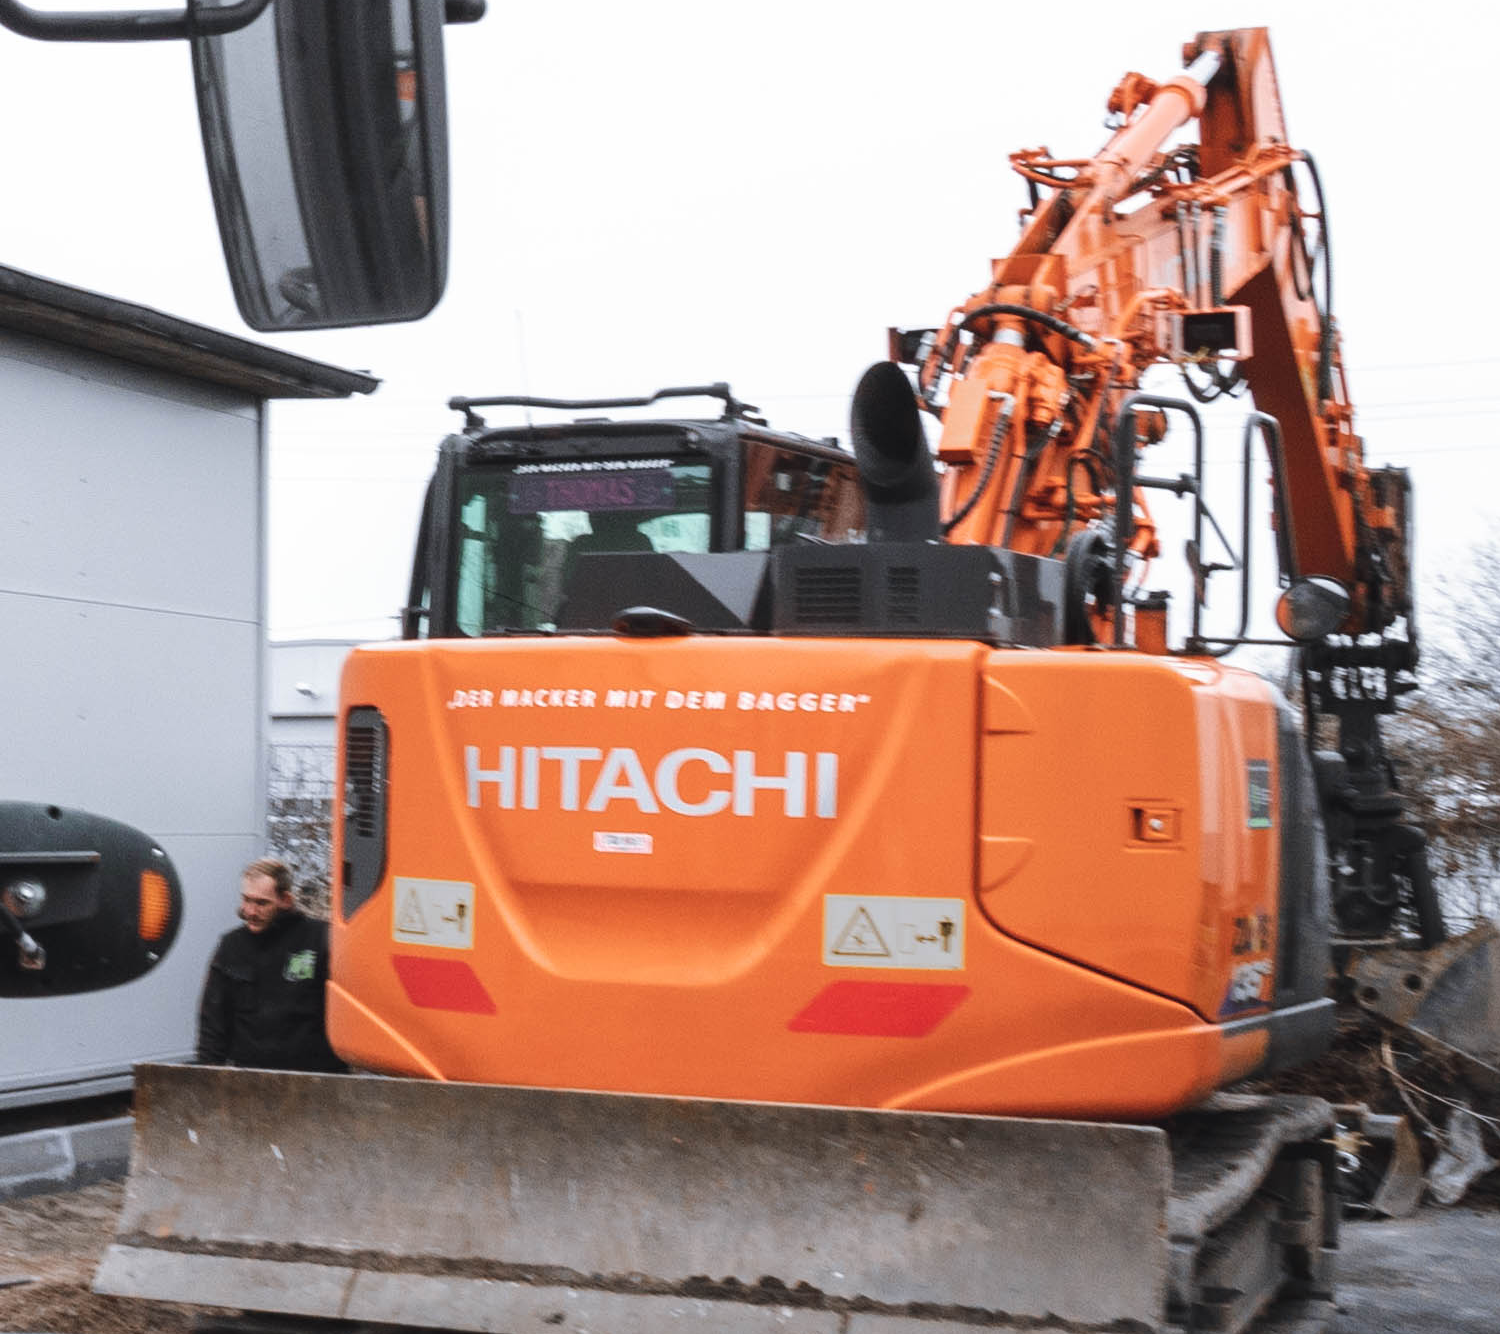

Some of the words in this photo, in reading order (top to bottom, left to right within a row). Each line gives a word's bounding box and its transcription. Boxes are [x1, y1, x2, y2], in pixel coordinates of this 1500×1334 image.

[500, 688, 597, 708] MACKER
[604, 689, 657, 709] MIT
[664, 690, 727, 710] DEM
[464, 745, 839, 819] HITACHI
